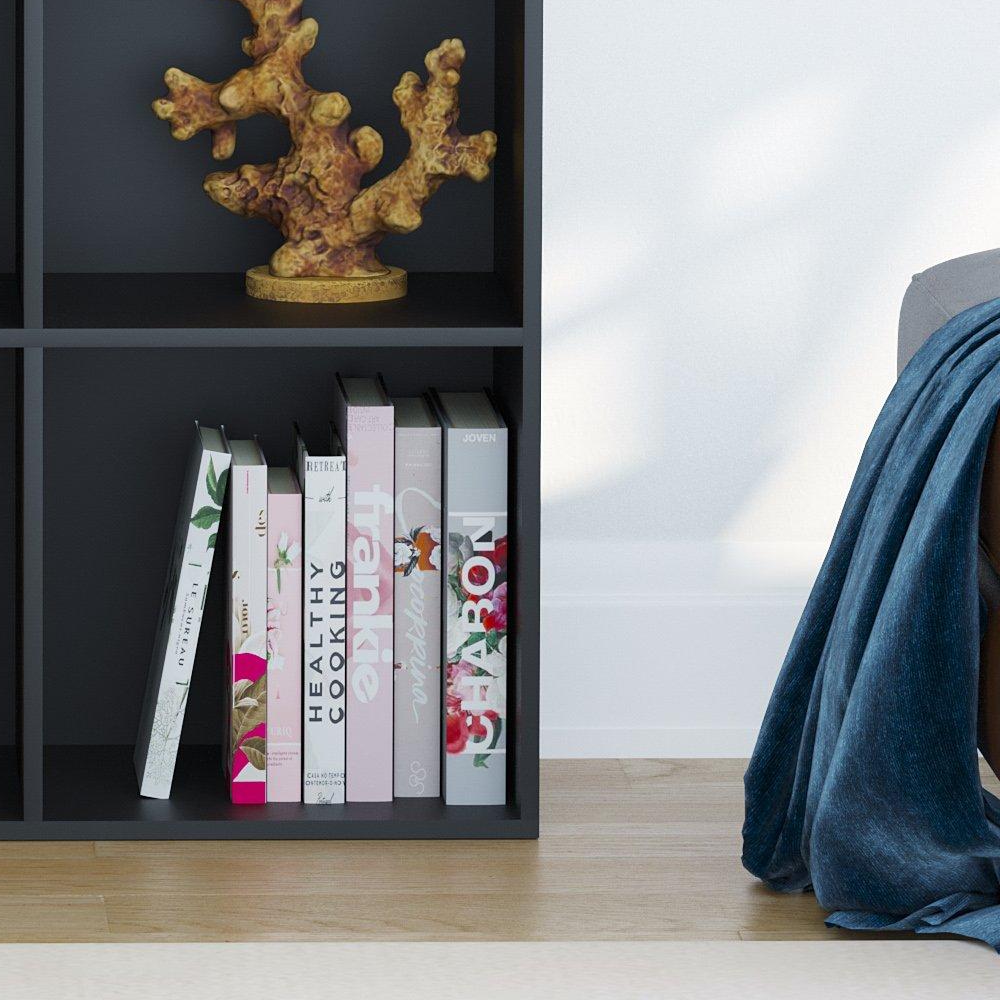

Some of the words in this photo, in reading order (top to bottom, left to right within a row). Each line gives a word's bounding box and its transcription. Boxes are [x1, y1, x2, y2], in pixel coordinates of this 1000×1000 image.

[462, 433, 497, 442] JOVEN
[178, 607, 194, 667] SUREAU
[191, 583, 199, 598] LE
[309, 562, 323, 723] HEALTHY
[329, 560, 345, 724] COOKING
[352, 484, 394, 704] frankie
[461, 516, 496, 751] CHABON
